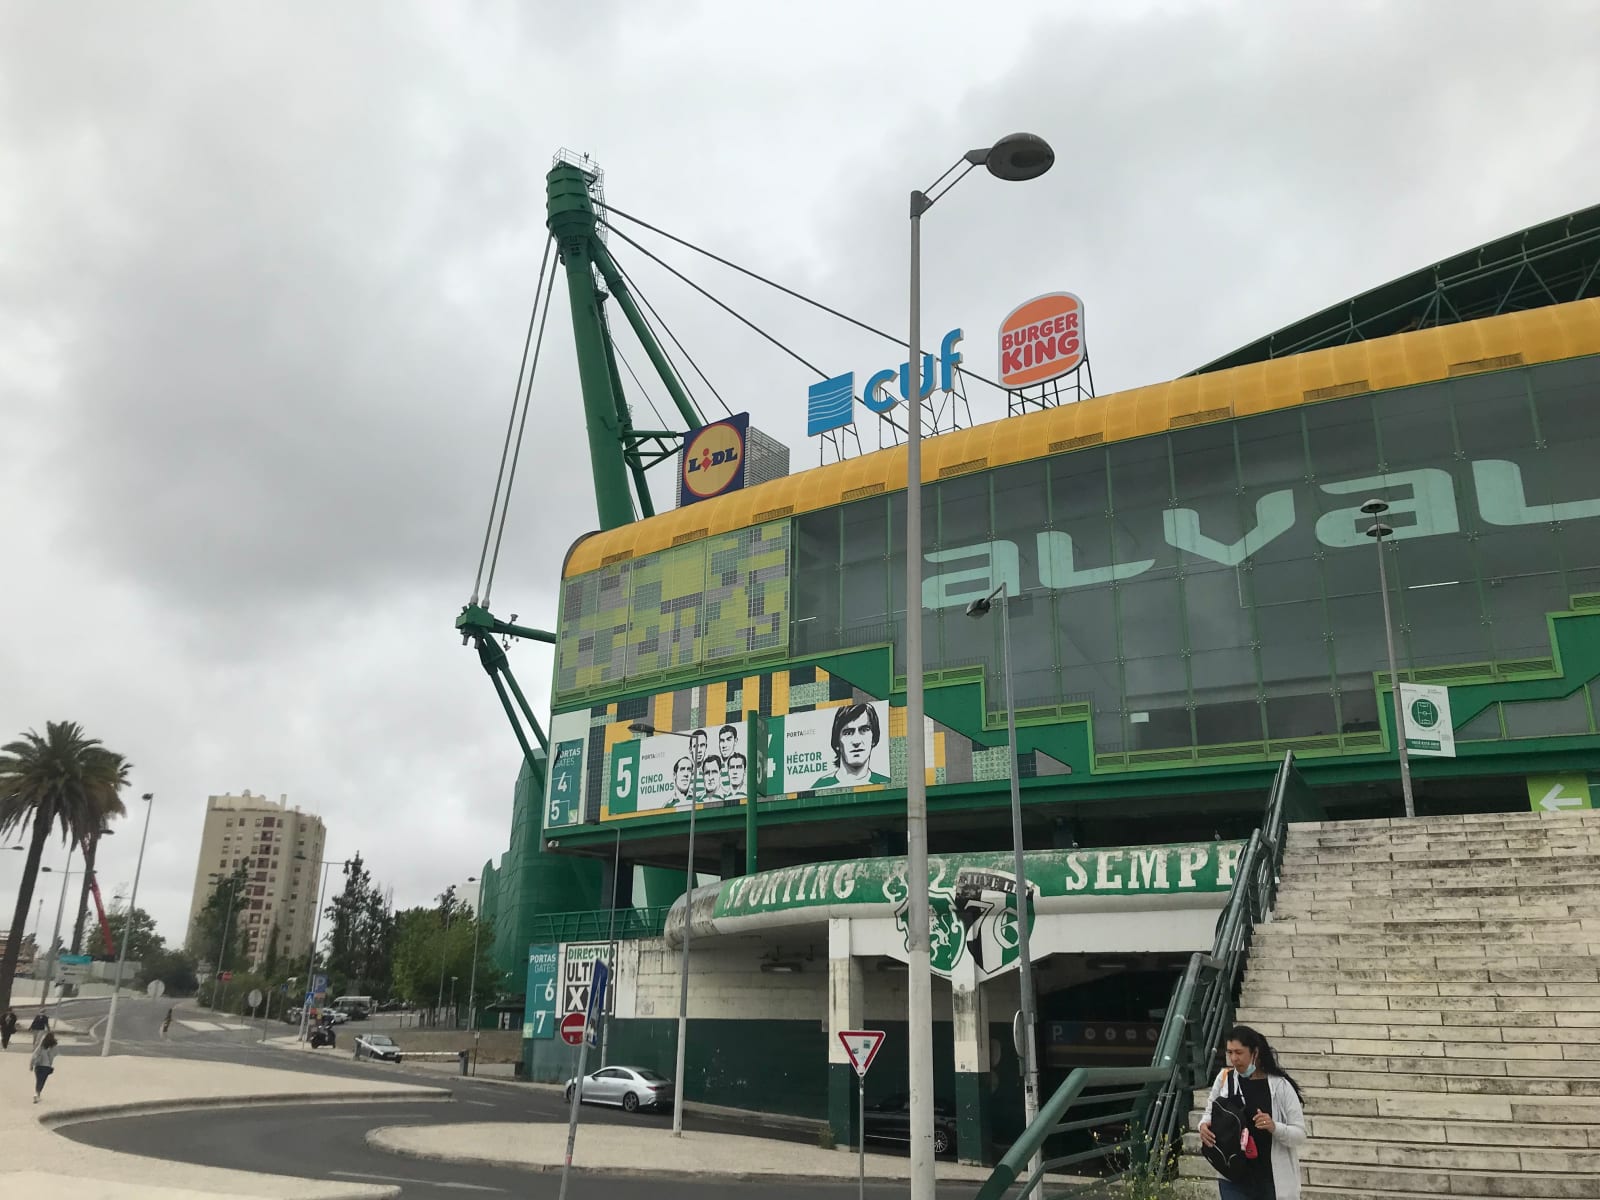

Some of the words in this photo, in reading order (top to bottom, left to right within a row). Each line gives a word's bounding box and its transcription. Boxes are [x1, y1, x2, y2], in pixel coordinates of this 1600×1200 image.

[1002, 313, 1079, 350] BURGER
[1002, 330, 1080, 375] KING
[864, 328, 964, 414] cuf
[558, 747, 581, 759] ORTAS
[786, 751, 823, 764] HÉCTOR
[616, 757, 633, 798] 5
[640, 773, 664, 785] CINCO
[786, 762, 828, 775] YAZALDE
[557, 771, 568, 792] 4
[640, 782, 675, 795] VIOLINOS
[551, 800, 560, 820] 5
[724, 862, 857, 910] SPORTING
[1066, 842, 1245, 891] SEMPR
[530, 953, 556, 964] PORTAS
[534, 963, 556, 973] GATES
[567, 961, 615, 984] ULT
[544, 978, 554, 1001] 6
[536, 1010, 546, 1034] 7
